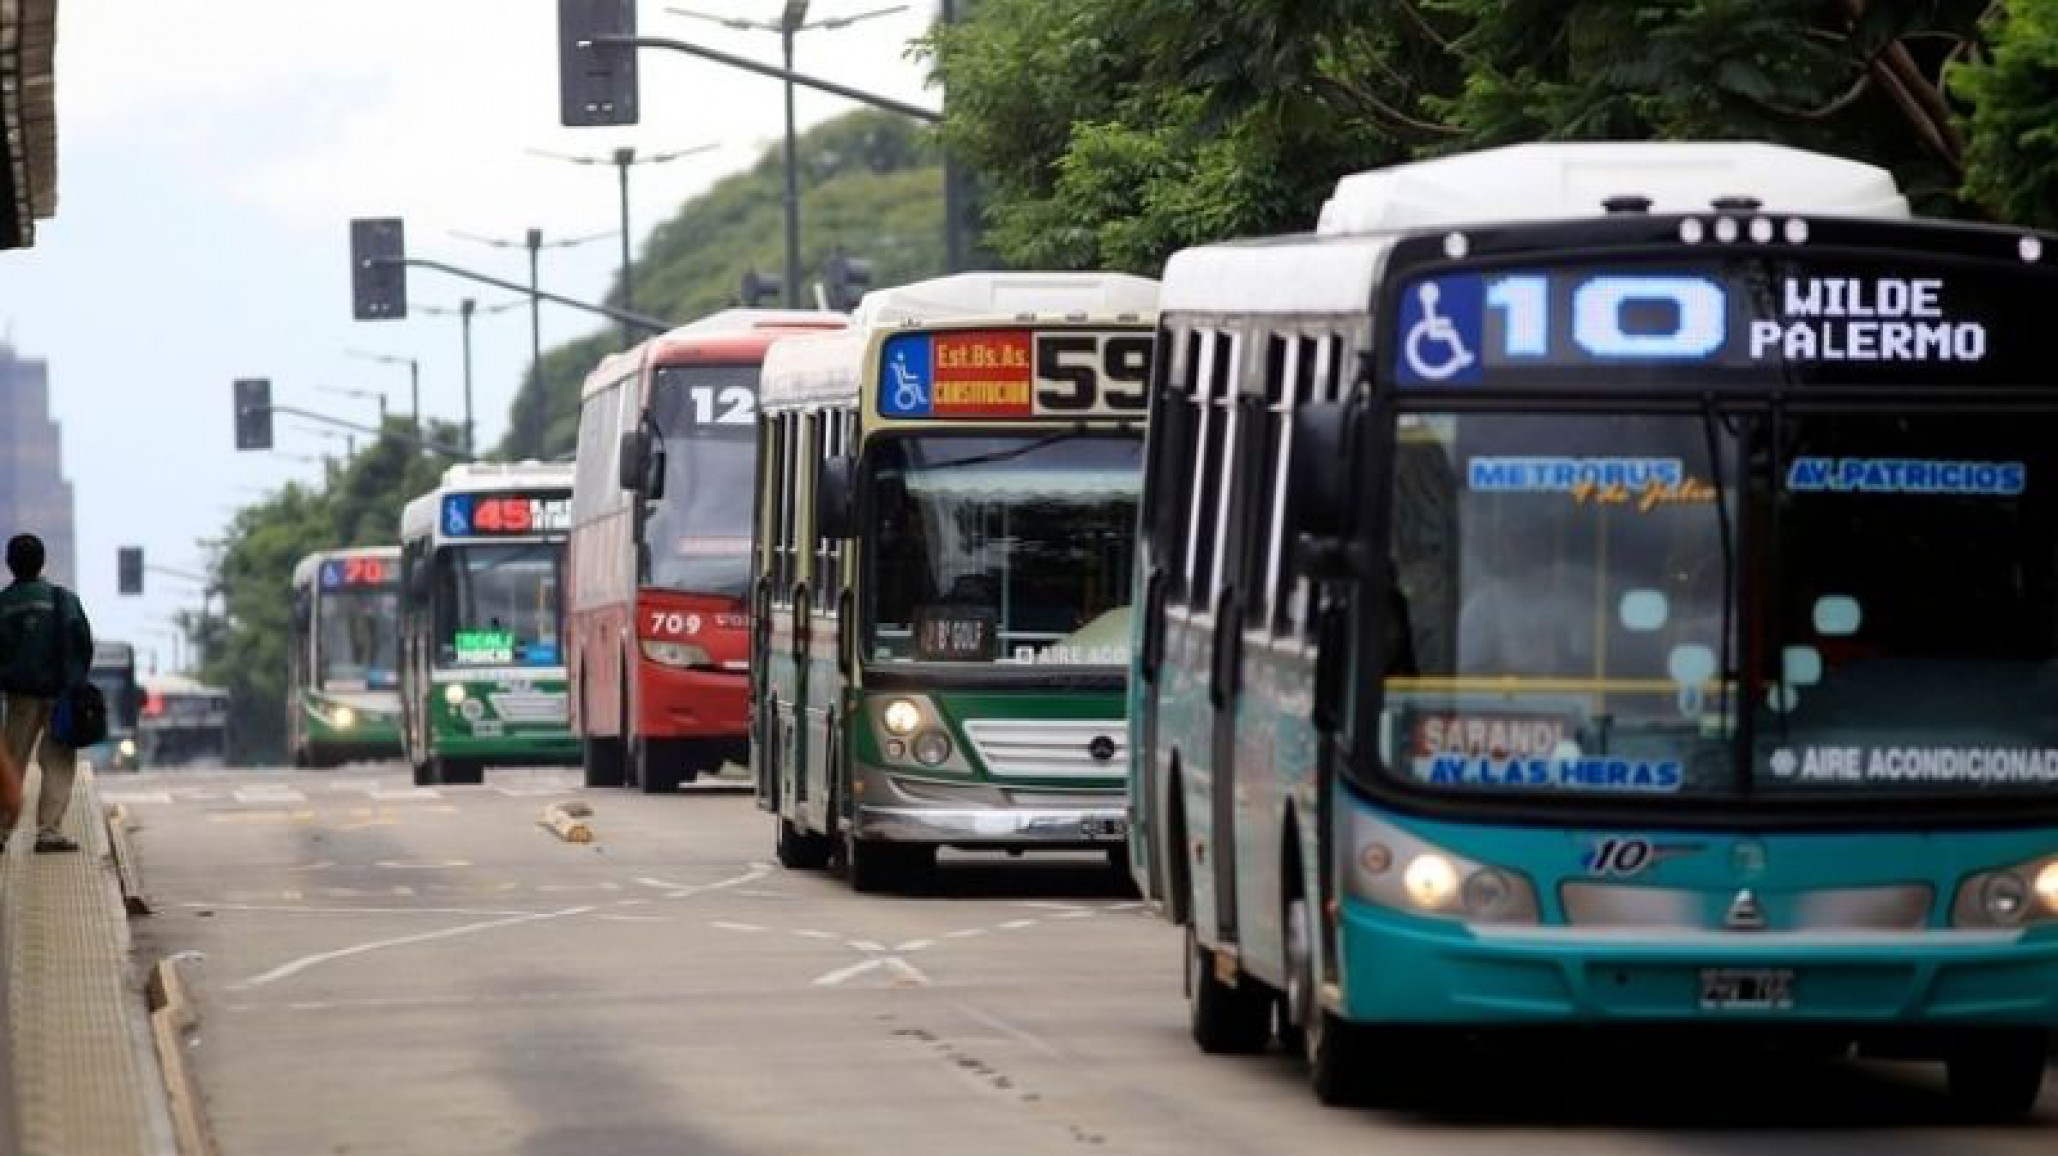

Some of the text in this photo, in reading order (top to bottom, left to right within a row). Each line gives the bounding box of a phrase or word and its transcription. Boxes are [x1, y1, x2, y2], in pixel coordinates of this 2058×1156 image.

[1784, 279, 1943, 319] WILDE
[1486, 274, 1728, 360] 10
[1749, 321, 1986, 361] PALERMO
[1036, 336, 1153, 411] 59
[1471, 460, 1682, 490] METROBUS
[472, 498, 531, 530] 45
[345, 558, 382, 583] 70
[651, 612, 701, 634] 709
[1557, 757, 1682, 790] HERAS
[1800, 747, 1862, 780] AIRE
[1594, 838, 1649, 873] 10
